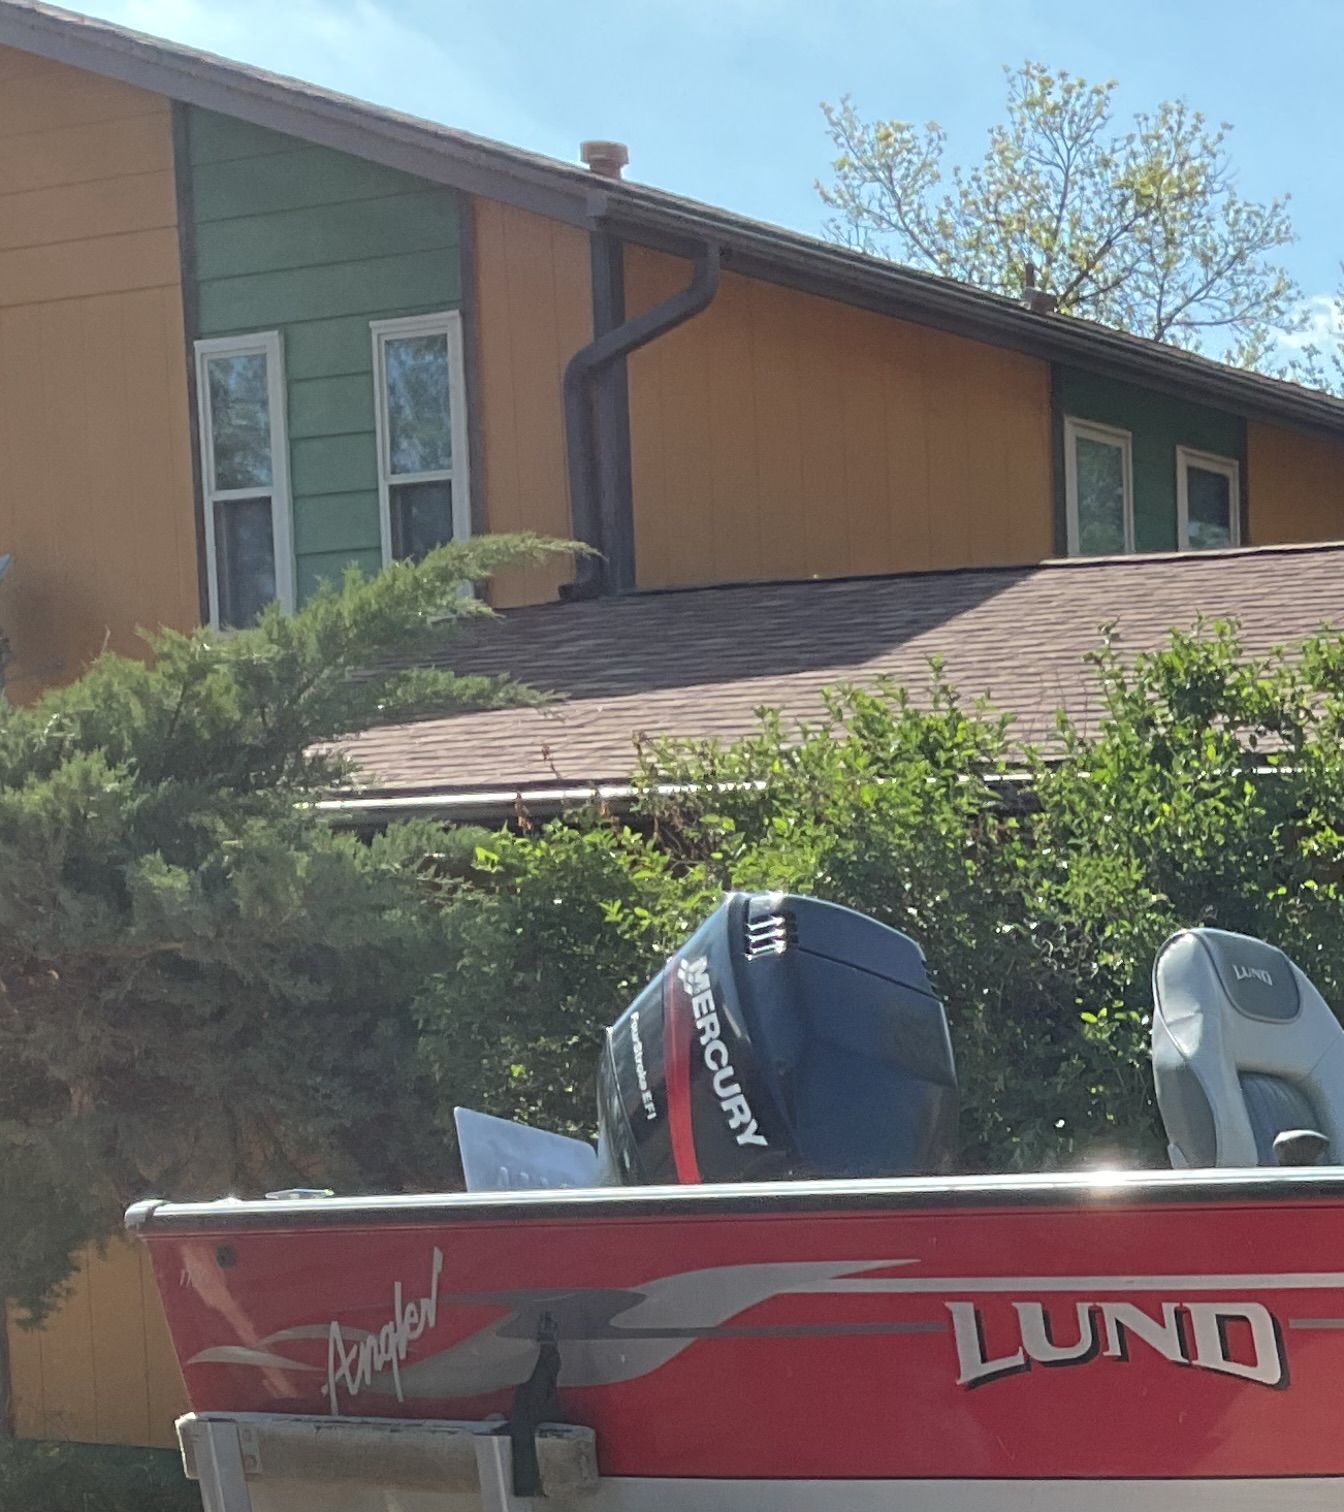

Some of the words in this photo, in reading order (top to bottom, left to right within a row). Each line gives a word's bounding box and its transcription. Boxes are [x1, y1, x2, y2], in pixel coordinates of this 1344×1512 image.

[642, 1089, 657, 1120] EFI
[678, 956, 768, 1146] MERCURY
[320, 1246, 443, 1416] Angler
[944, 1301, 1290, 1391] LUND
